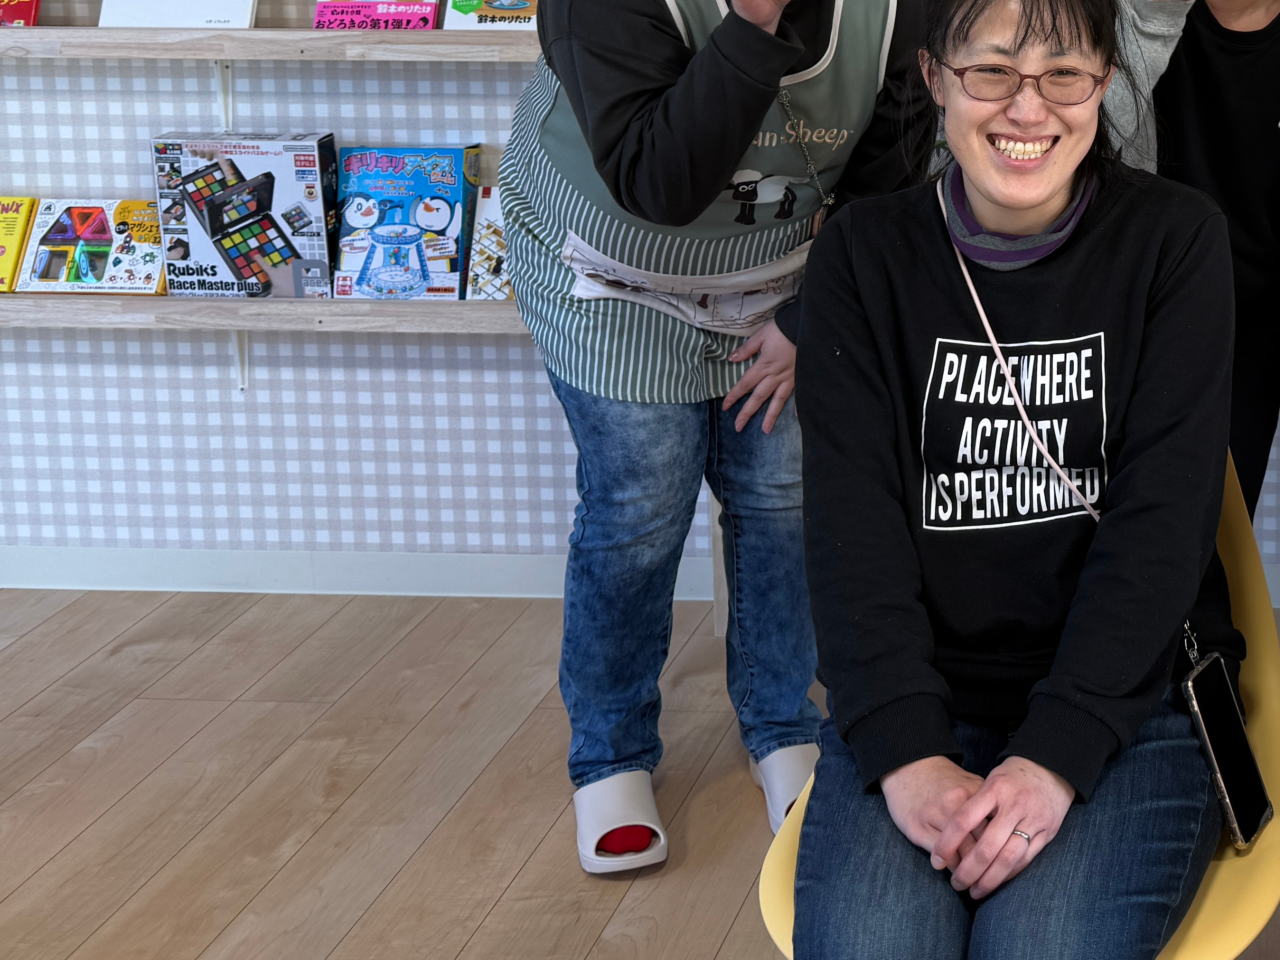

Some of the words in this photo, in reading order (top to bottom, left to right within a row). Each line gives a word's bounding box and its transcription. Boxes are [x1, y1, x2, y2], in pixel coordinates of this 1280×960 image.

[376, 4, 431, 14] 鈴木のりたけ
[477, 14, 532, 24] 鈴木のりたけ
[785, 120, 849, 151] Sheep
[168, 278, 196, 291] Race
[197, 278, 236, 291] Master
[236, 279, 262, 293] plus
[956, 416, 1068, 468] ACTIVITY
